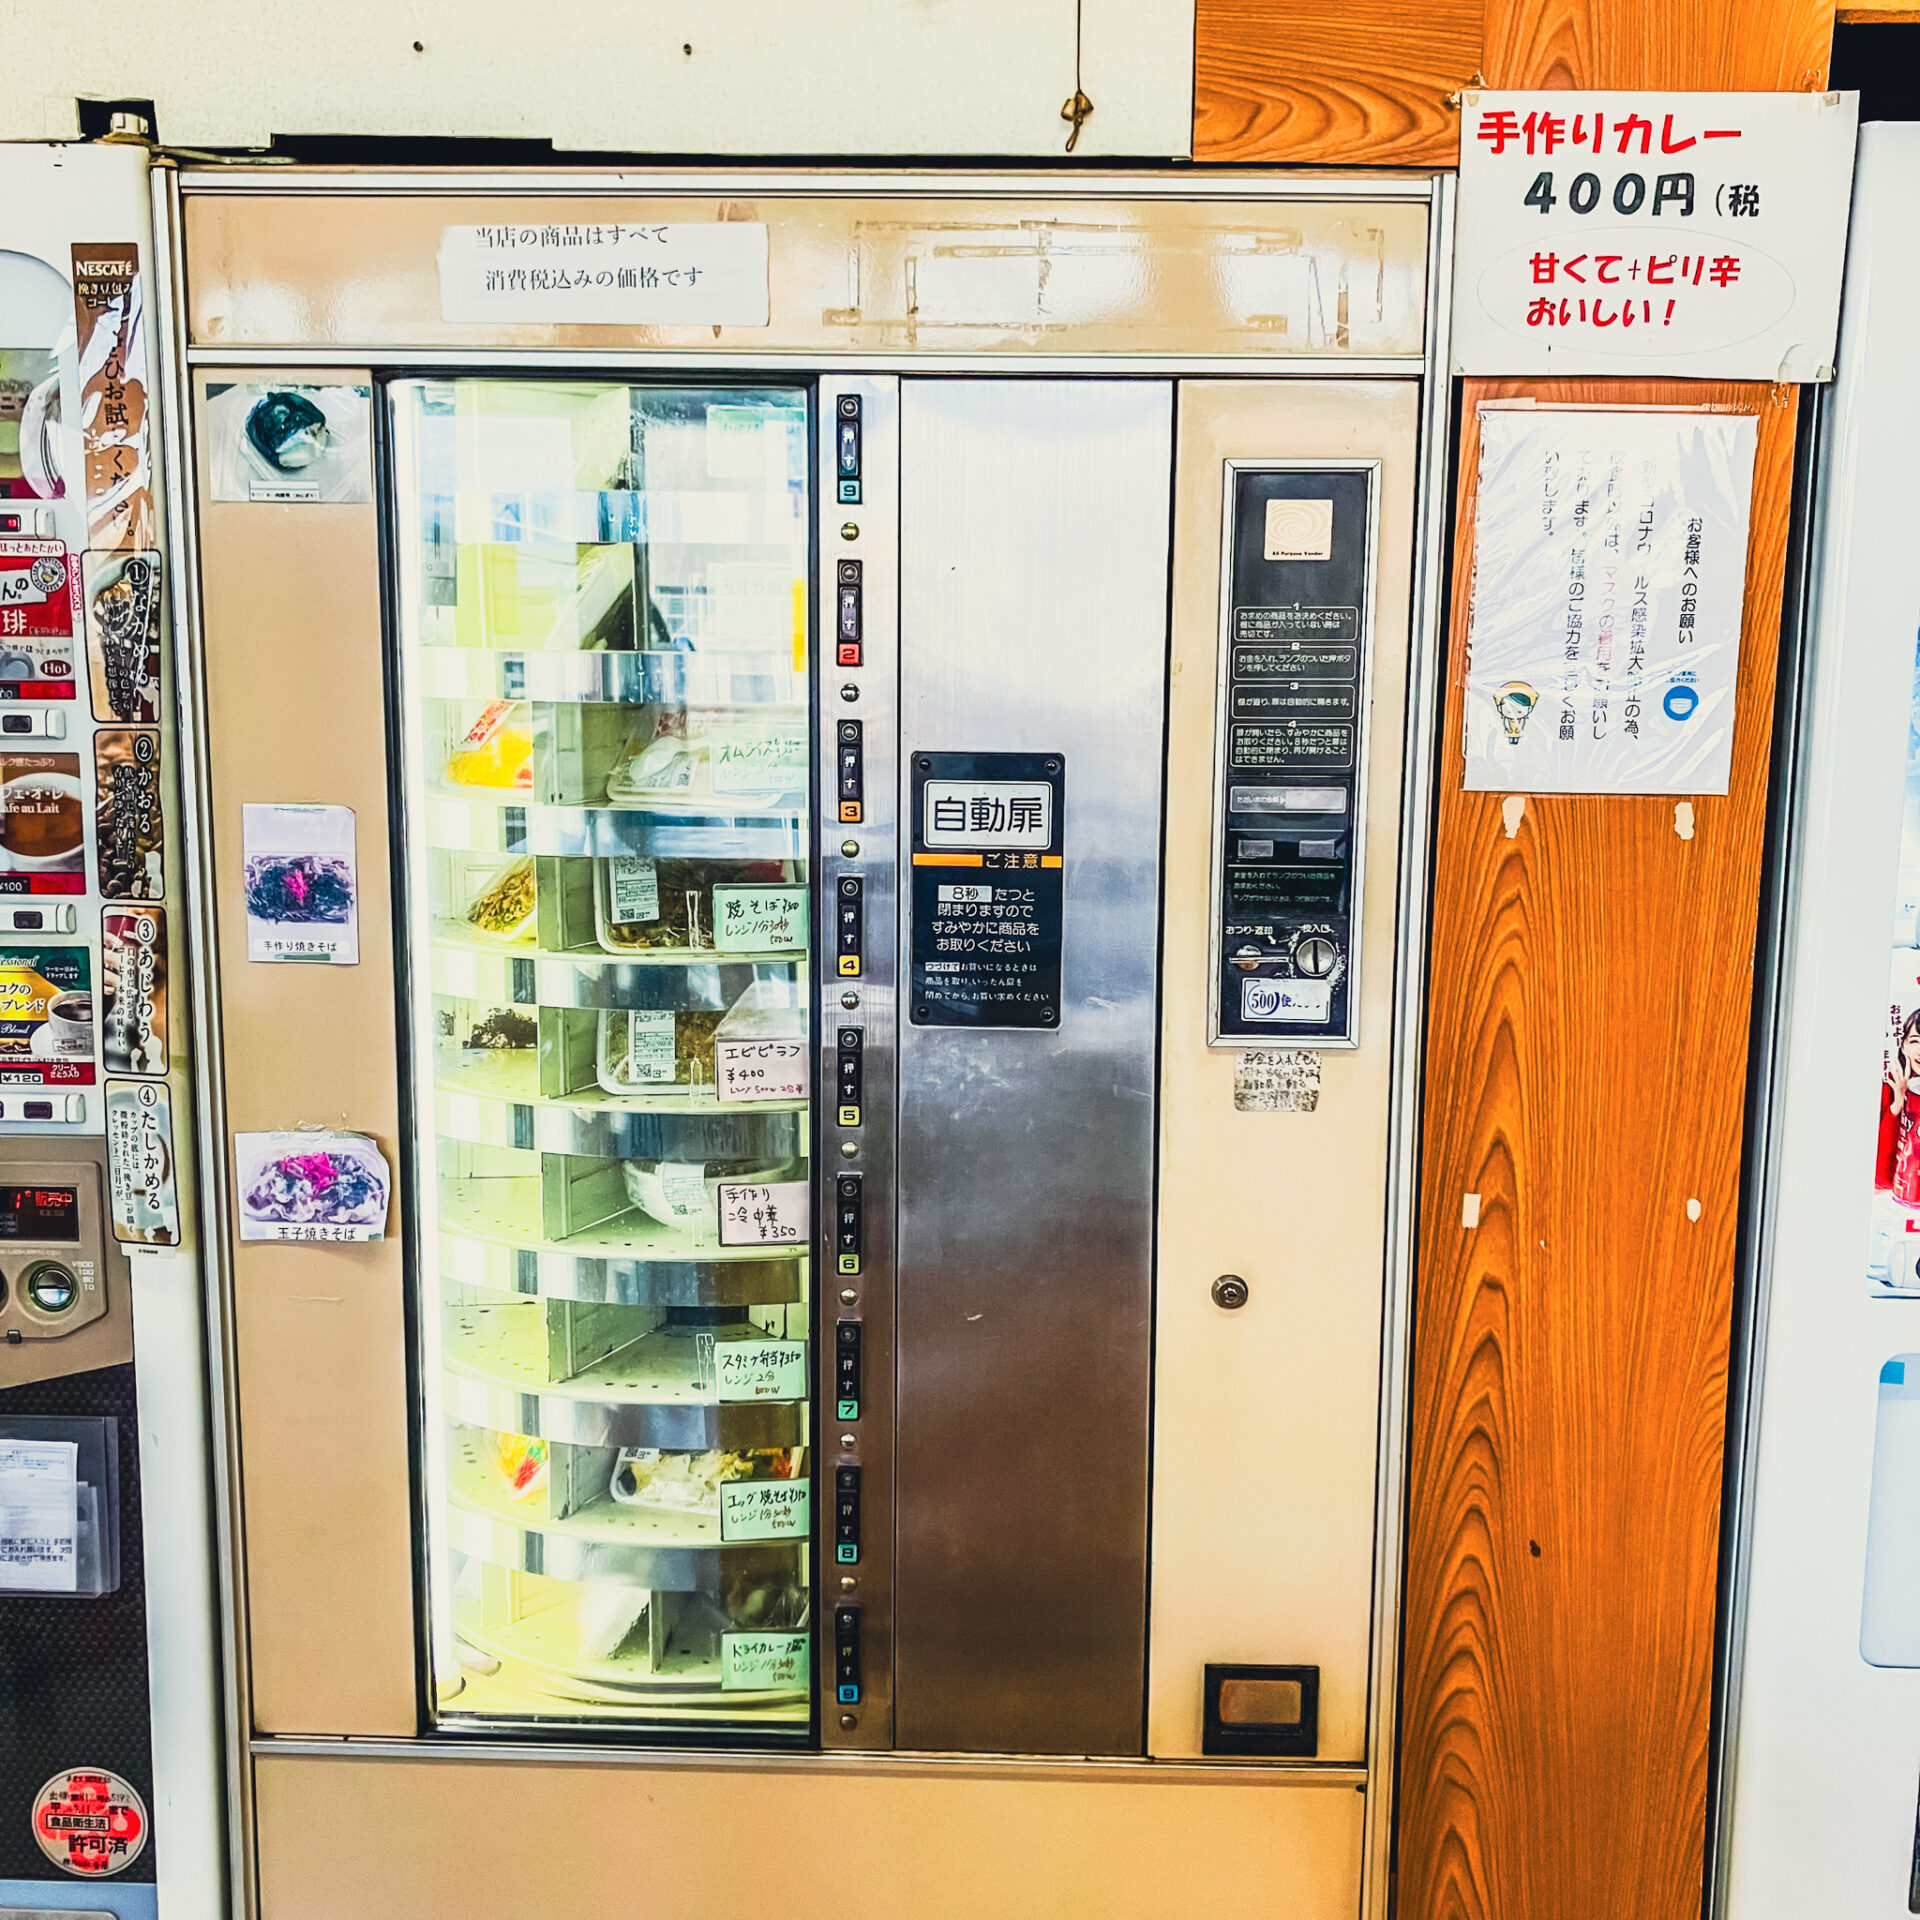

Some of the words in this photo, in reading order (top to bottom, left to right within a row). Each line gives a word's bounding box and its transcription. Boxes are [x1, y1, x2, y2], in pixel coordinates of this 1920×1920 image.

[1476, 110, 1743, 155] 手作りカレー
[1523, 171, 1696, 217] 400円
[475, 225, 670, 249] 当店の商品はすべて
[75, 260, 133, 276] NESCAFÉ
[485, 266, 704, 291] 消費税込みの価格です
[1678, 518, 1703, 644] お客様へのお願い
[43, 662, 67, 675] Hot
[37, 802, 60, 814] Lait
[934, 796, 1043, 833] 自動扉
[986, 853, 1038, 869] ご注意
[952, 887, 979, 901] 8秒
[995, 889, 1035, 901] たつと
[937, 903, 1034, 918] 閉まりますので
[932, 921, 1040, 936] すみやかに商品を
[264, 940, 338, 952] 手作り焼きそば
[936, 939, 1031, 953] お取りください
[138, 948, 154, 1043] あじわう
[725, 1043, 801, 1060] エビピラフ
[3, 1073, 42, 1083] ¥120
[725, 1067, 765, 1083] ¥400
[141, 1111, 161, 1210] たしかめる
[35, 1191, 72, 1207] 販売中
[725, 1187, 770, 1204] 手作り
[277, 1226, 357, 1241] 玉子焼きそば
[759, 1225, 796, 1240] ¥350
[50, 1817, 107, 1830] 食品衛生法
[68, 1834, 129, 1855] 許可済
